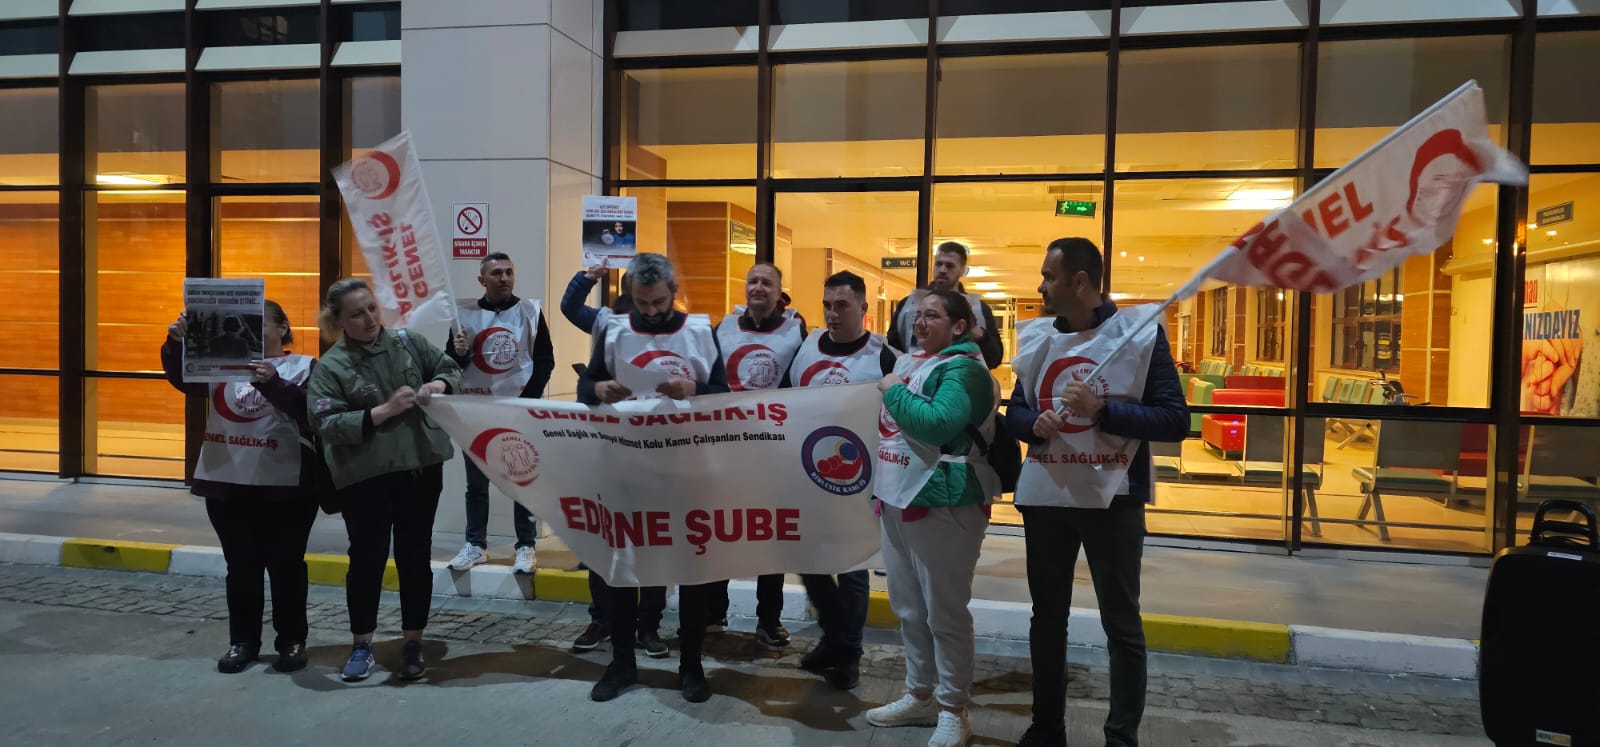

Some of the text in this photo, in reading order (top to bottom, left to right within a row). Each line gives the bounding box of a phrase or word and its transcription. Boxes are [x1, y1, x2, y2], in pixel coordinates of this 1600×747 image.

[543, 429, 565, 438] Genel
[643, 439, 663, 449] Kolu
[666, 437, 691, 448] Kamu
[693, 432, 741, 447] Çalışanları
[743, 431, 786, 441] Sendikası
[560, 493, 801, 555] EDİRNE ŞUBE
